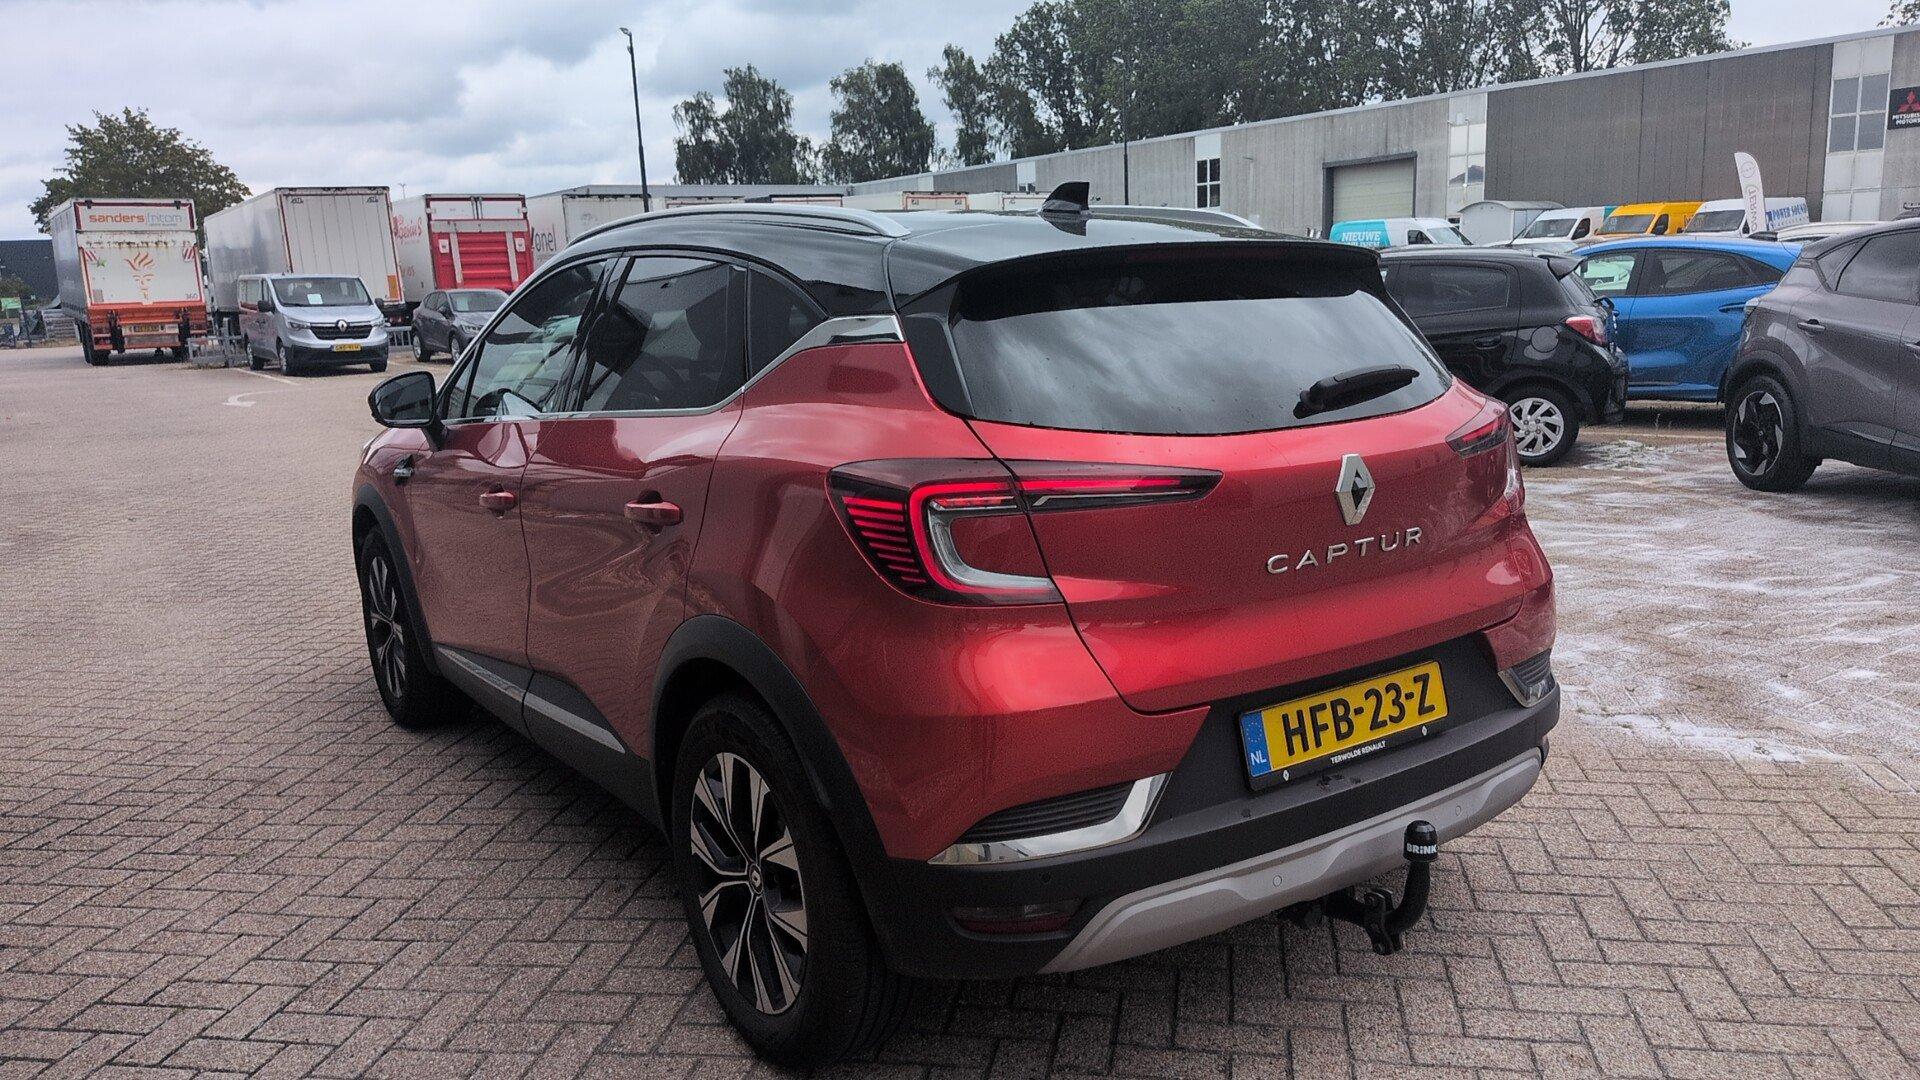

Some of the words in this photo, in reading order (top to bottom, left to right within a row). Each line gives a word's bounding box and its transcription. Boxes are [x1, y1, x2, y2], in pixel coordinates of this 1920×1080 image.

[88, 212, 145, 223] sanders
[1342, 231, 1381, 241] NIEUWE
[1267, 526, 1423, 574] CAPTUR
[1250, 750, 1267, 766] NL
[1281, 672, 1436, 757] HFB-23-Z
[1330, 748, 1361, 765] TERWOLDE
[1361, 740, 1386, 756] RENAULT
